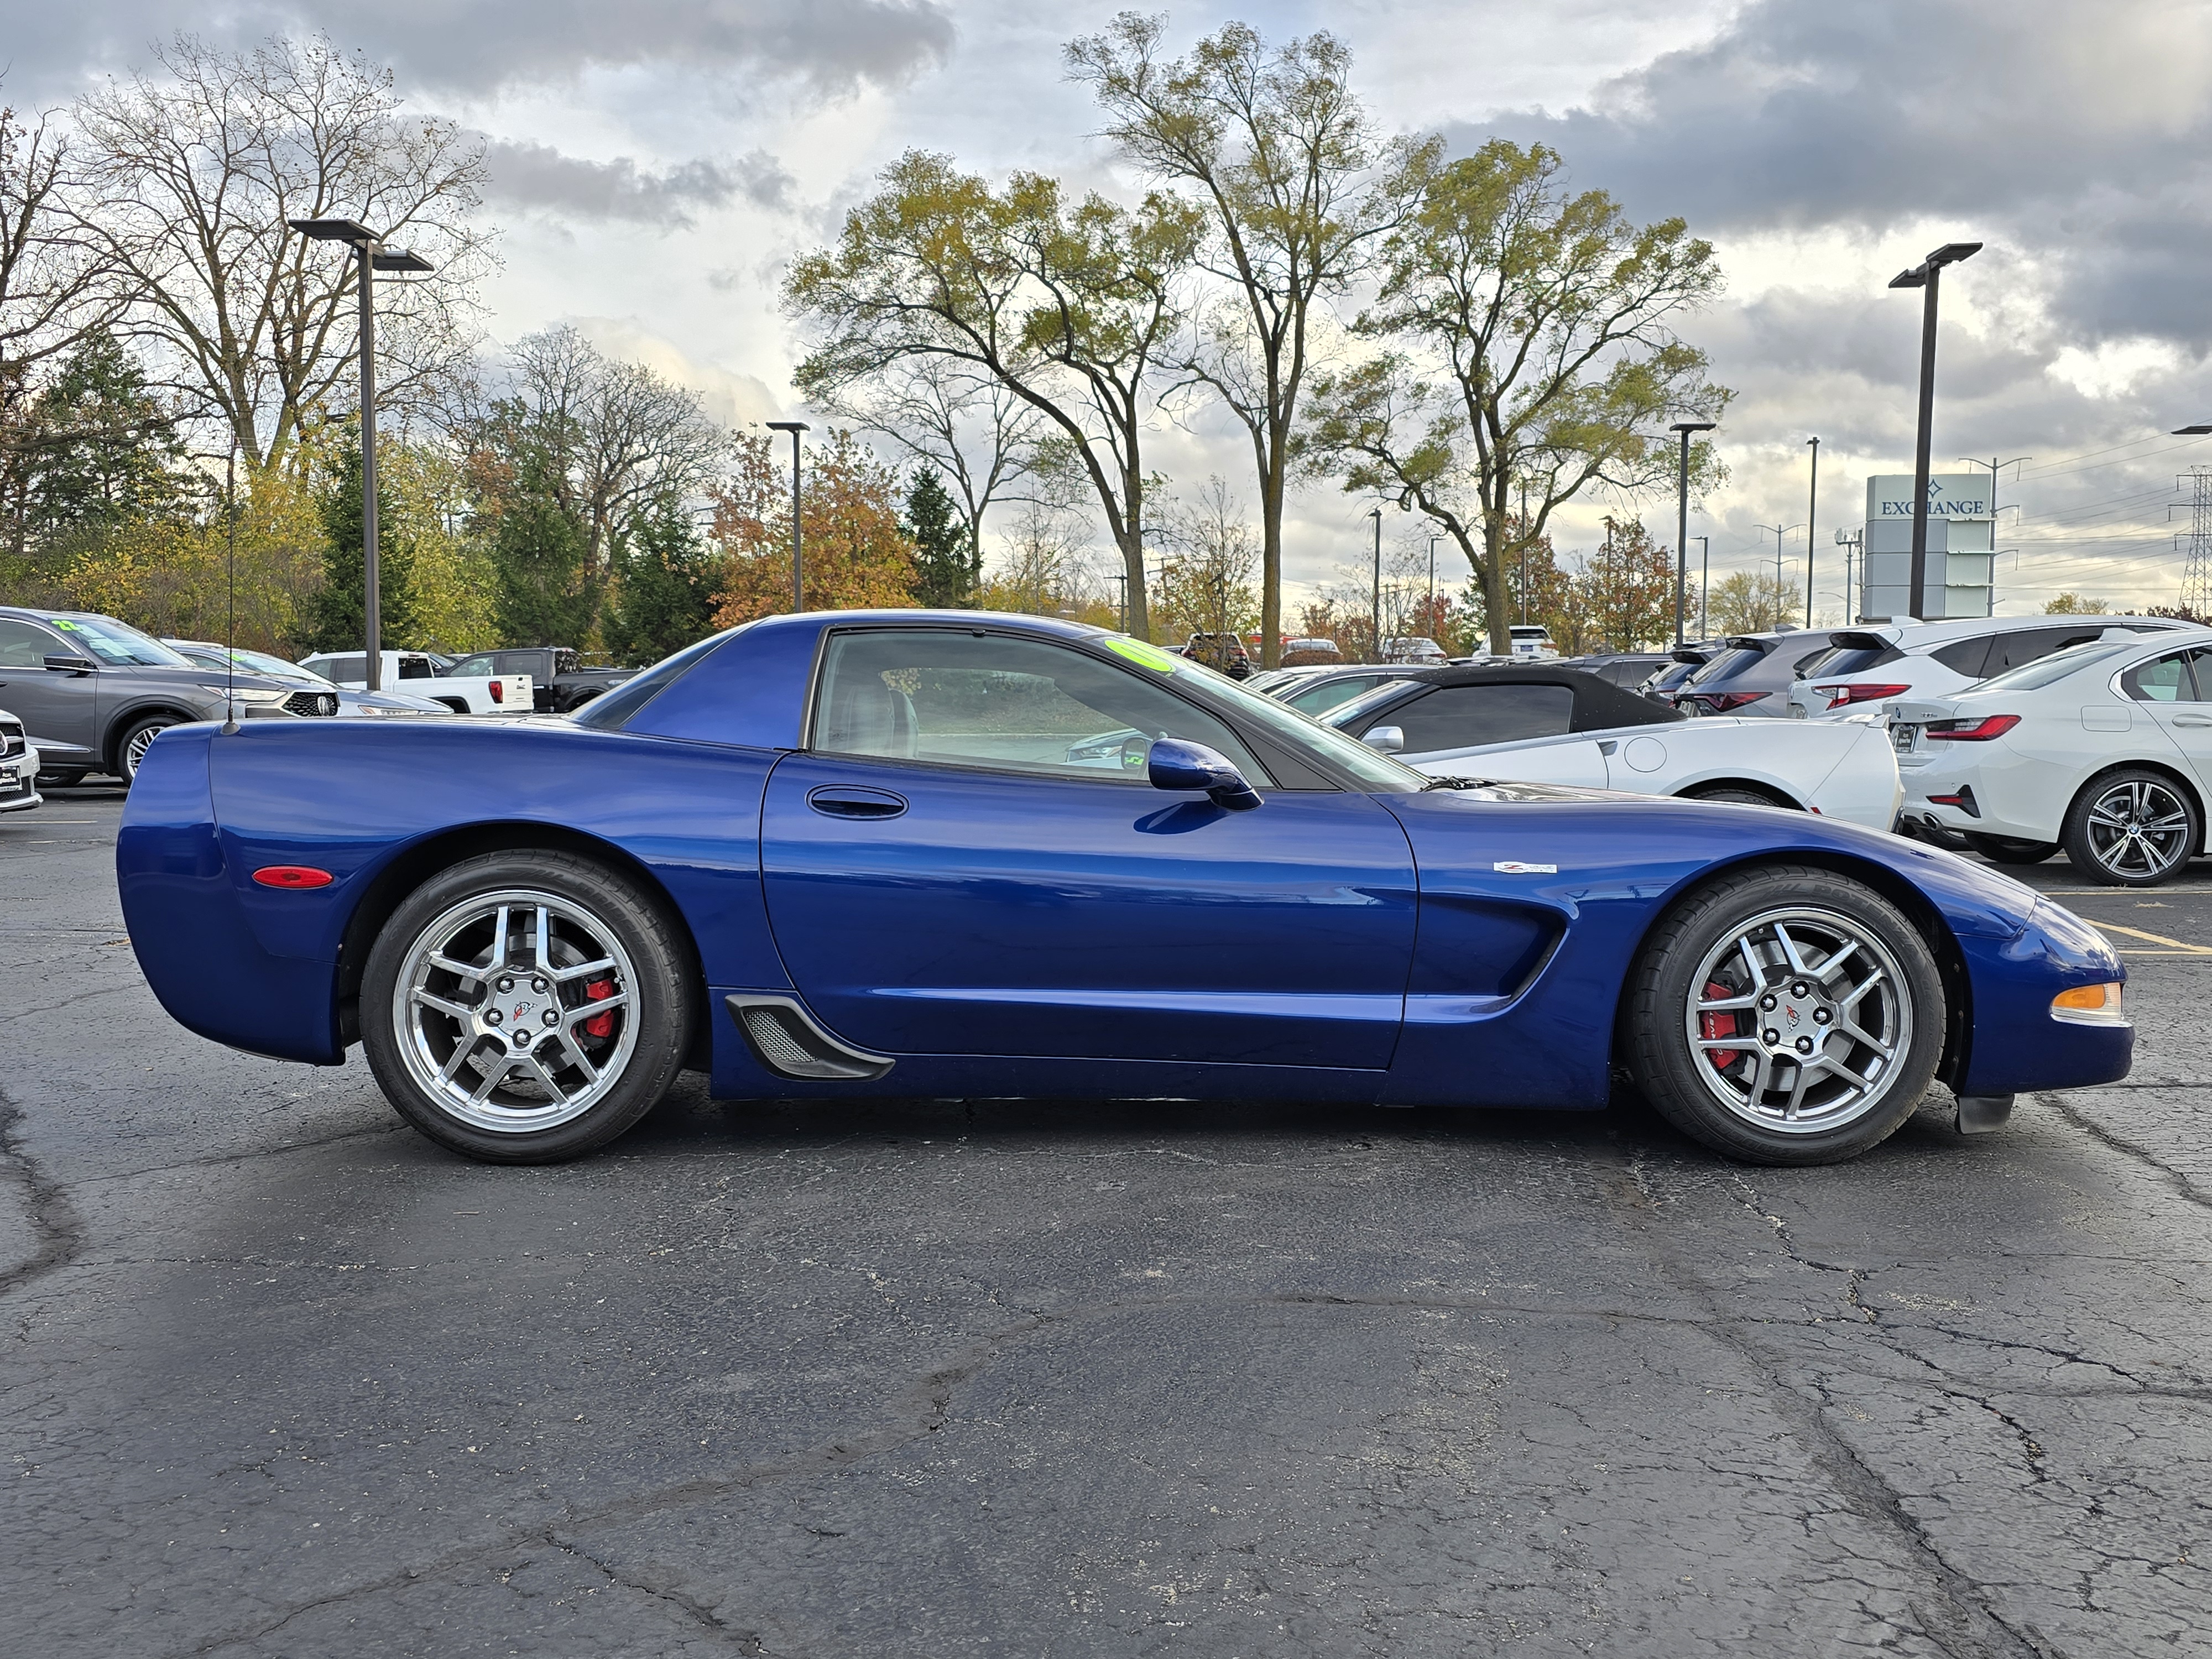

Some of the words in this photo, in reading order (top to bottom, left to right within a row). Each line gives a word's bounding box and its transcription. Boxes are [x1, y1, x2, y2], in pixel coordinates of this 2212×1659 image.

[51, 620, 82, 631] 22
[1811, 883, 1922, 962] POTENZA
[369, 1025, 448, 1138] POTENZA
